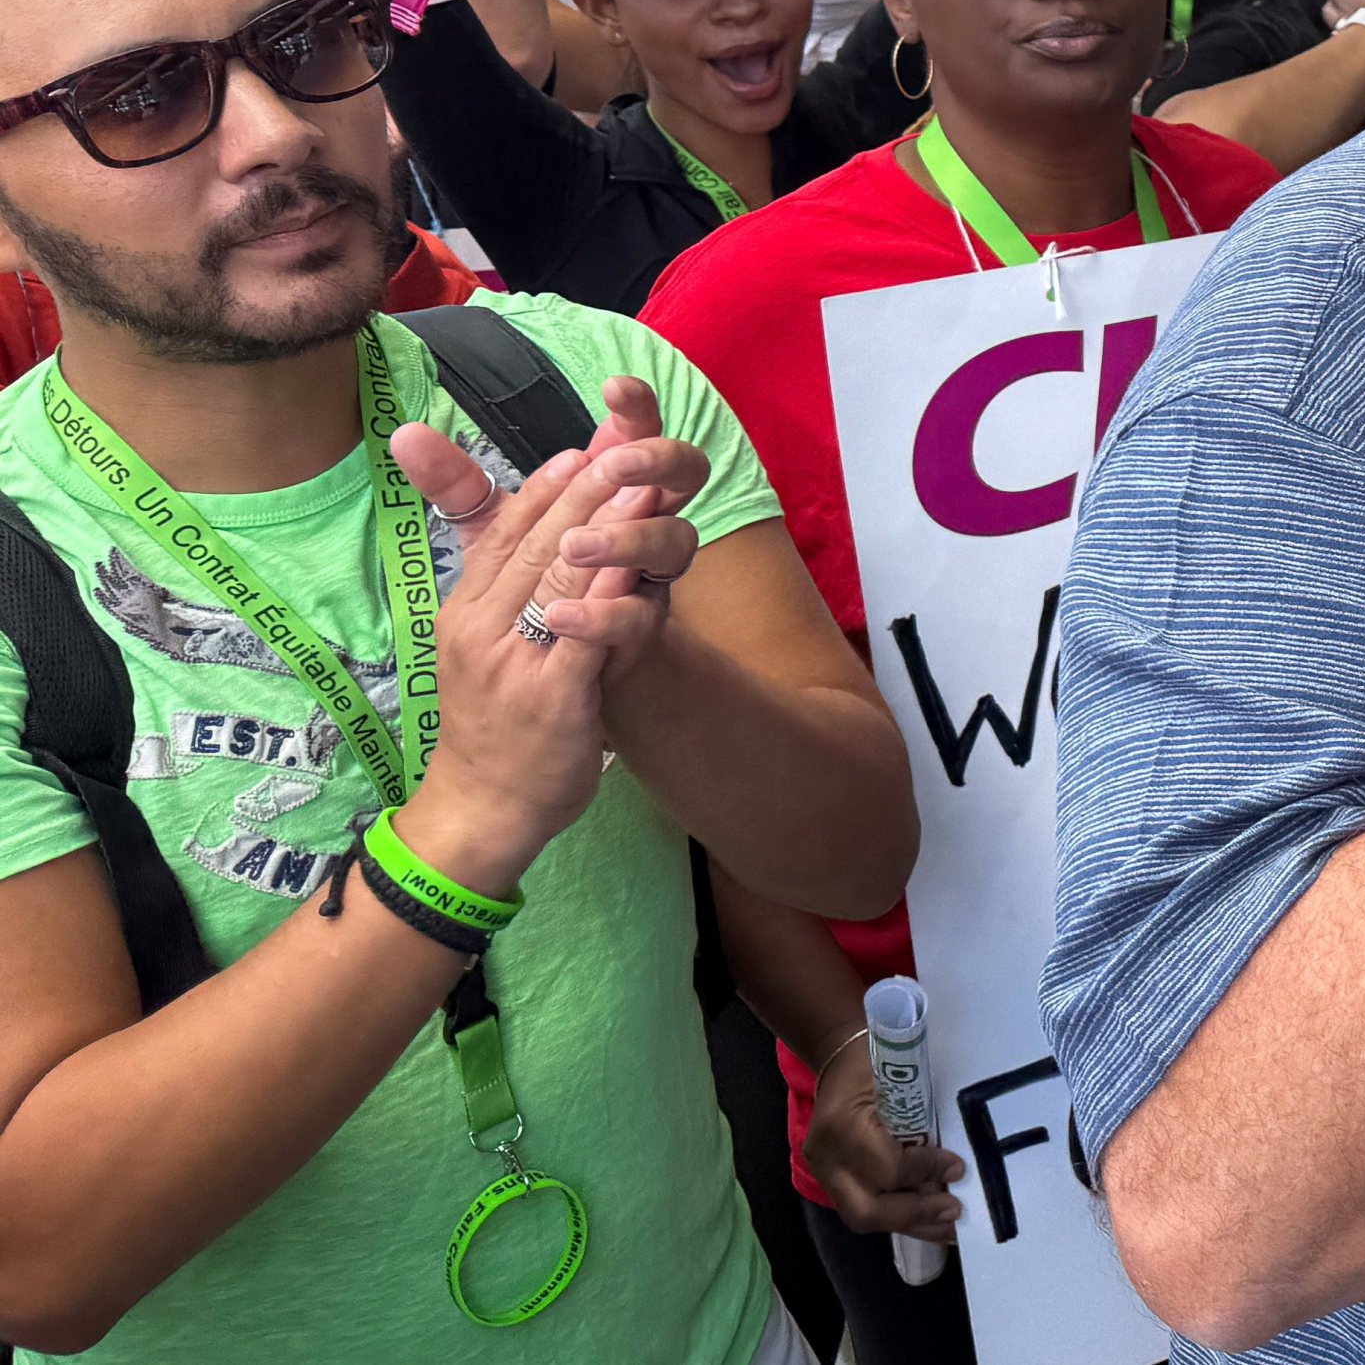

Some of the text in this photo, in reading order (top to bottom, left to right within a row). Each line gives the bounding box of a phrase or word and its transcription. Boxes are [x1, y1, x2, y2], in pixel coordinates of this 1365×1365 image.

[50, 398, 131, 492] Détours.
[134, 484, 174, 527] Un
[170, 523, 260, 607] Contrat
[252, 604, 353, 713] Équitable
[190, 715, 298, 767] EST.
[401, 869, 456, 911] Now!
